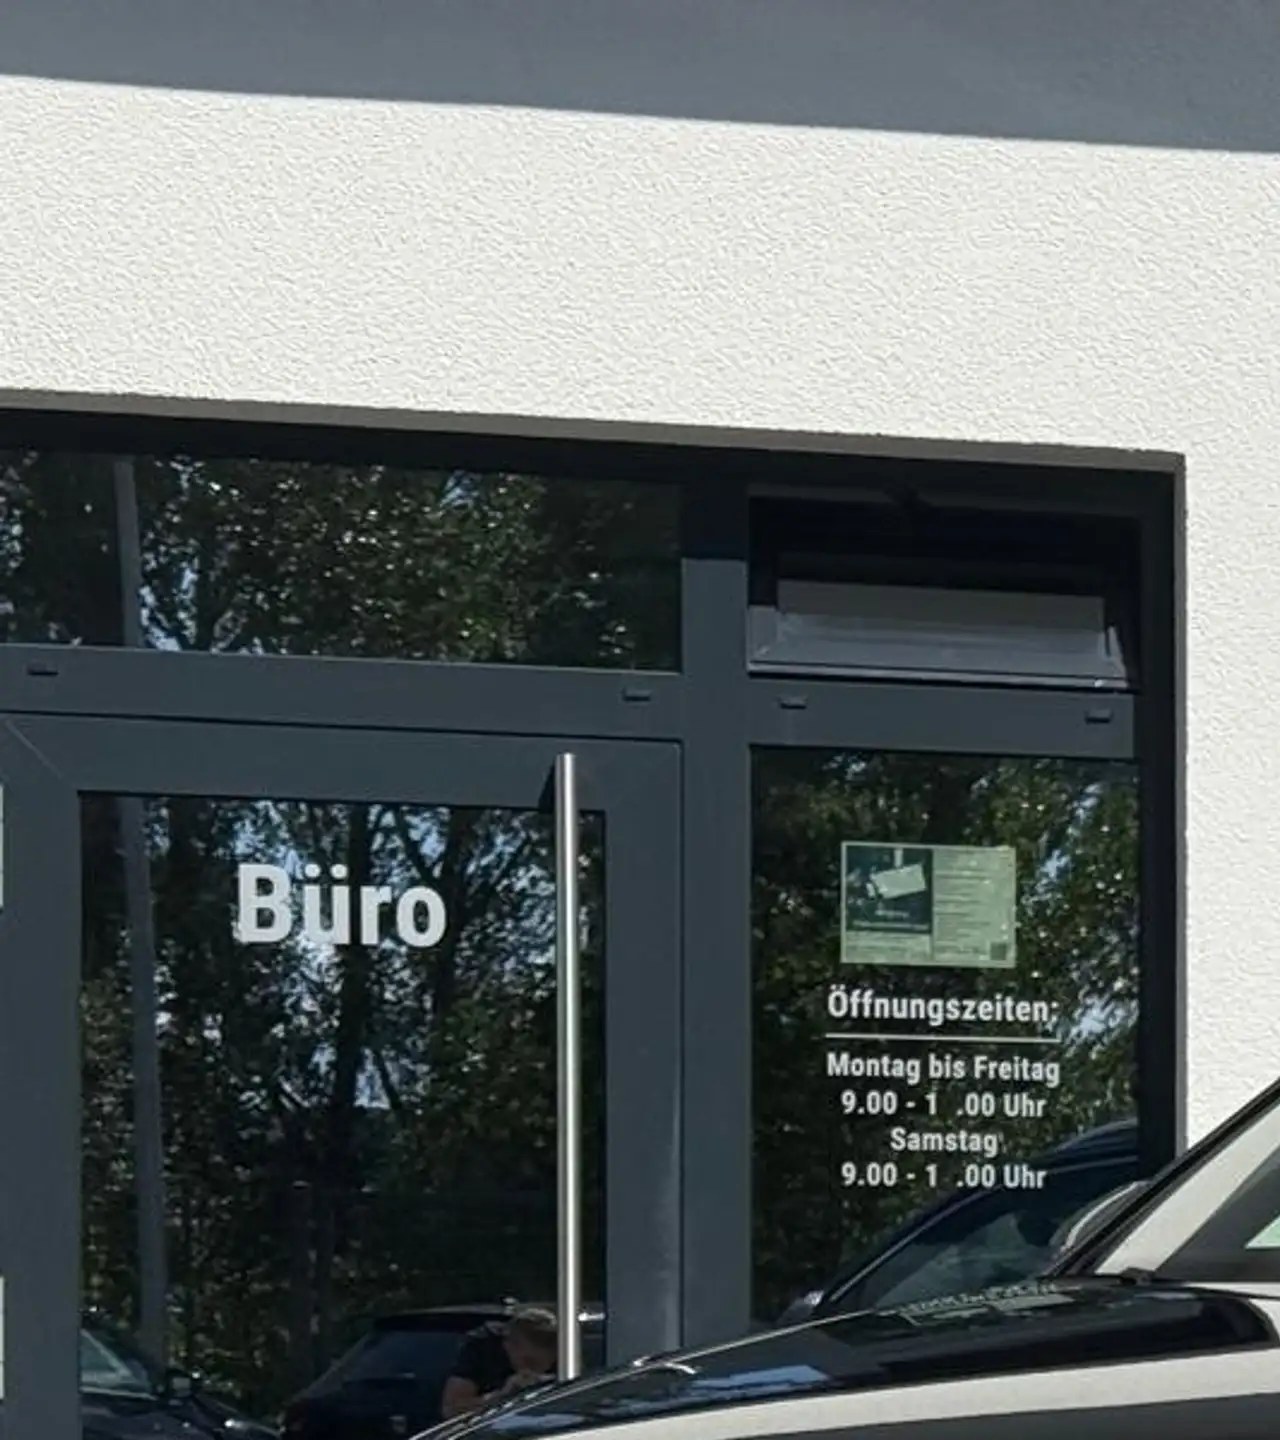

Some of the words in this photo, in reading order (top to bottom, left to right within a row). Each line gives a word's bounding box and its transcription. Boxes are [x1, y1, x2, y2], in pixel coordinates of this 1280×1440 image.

[237, 863, 447, 948] Büro
[827, 984, 1060, 1027] Öffnungszeiten:
[826, 1052, 921, 1085] Montag
[928, 1053, 966, 1080] bis
[973, 1055, 1061, 1088] Freitag
[840, 1089, 898, 1115] 9.00
[1003, 1092, 1048, 1117] Uhr
[890, 1126, 998, 1158] Samstag
[841, 1161, 898, 1187] 9.00
[1003, 1163, 1048, 1189] Uhr
